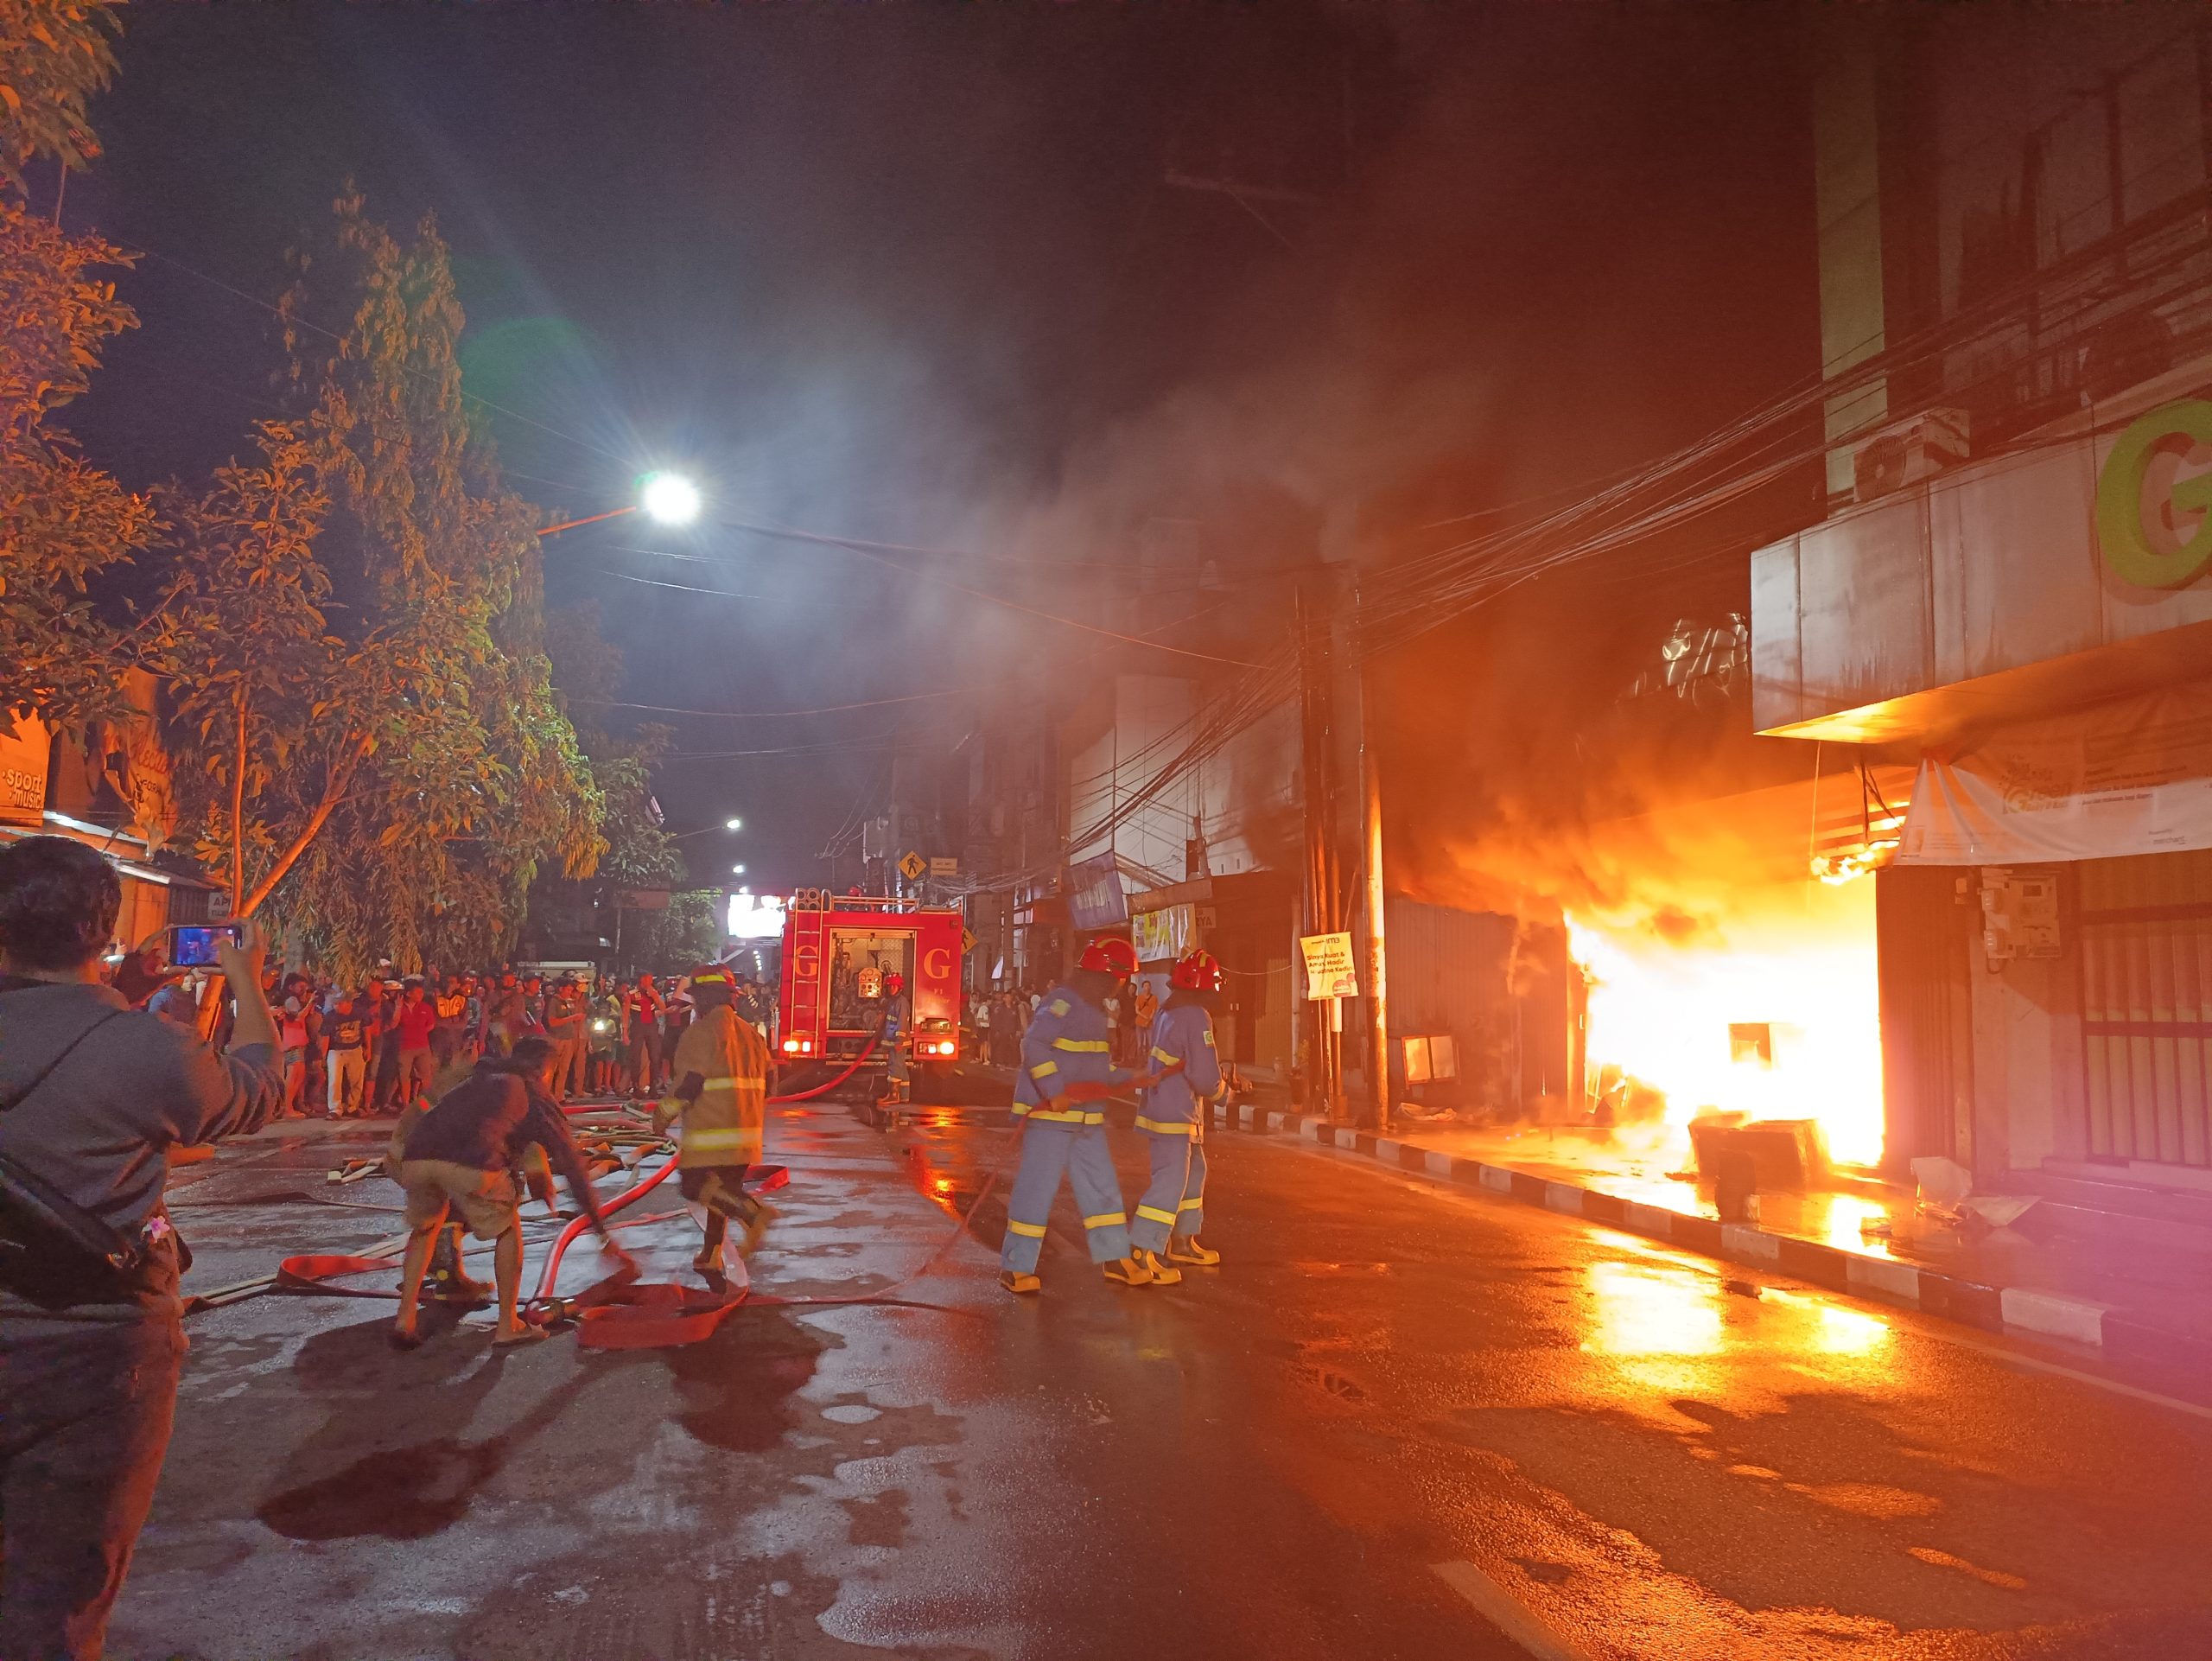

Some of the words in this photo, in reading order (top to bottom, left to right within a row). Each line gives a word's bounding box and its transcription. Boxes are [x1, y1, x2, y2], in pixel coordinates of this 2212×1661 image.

[7, 768, 41, 793] sport
[14, 789, 41, 809] music
[794, 945, 818, 977] G
[923, 947, 951, 979] G
